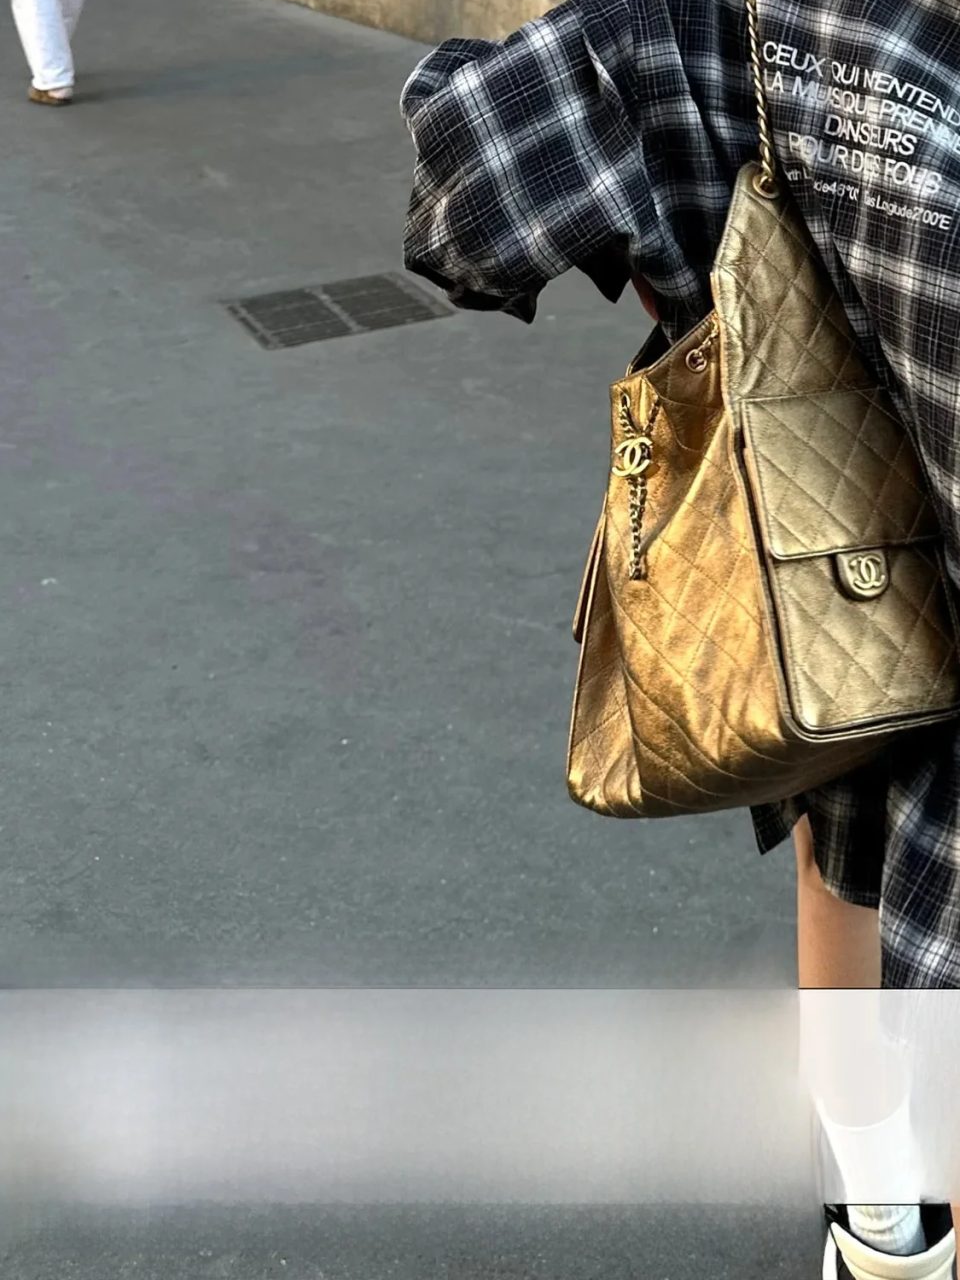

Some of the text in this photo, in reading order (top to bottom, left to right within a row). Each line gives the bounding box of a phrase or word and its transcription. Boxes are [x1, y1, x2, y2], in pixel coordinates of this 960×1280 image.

[763, 40, 825, 77] CEUX
[831, 60, 859, 87] QUI
[763, 68, 784, 93] LA
[788, 131, 848, 169] POUR
[824, 113, 918, 156] DANSEURS
